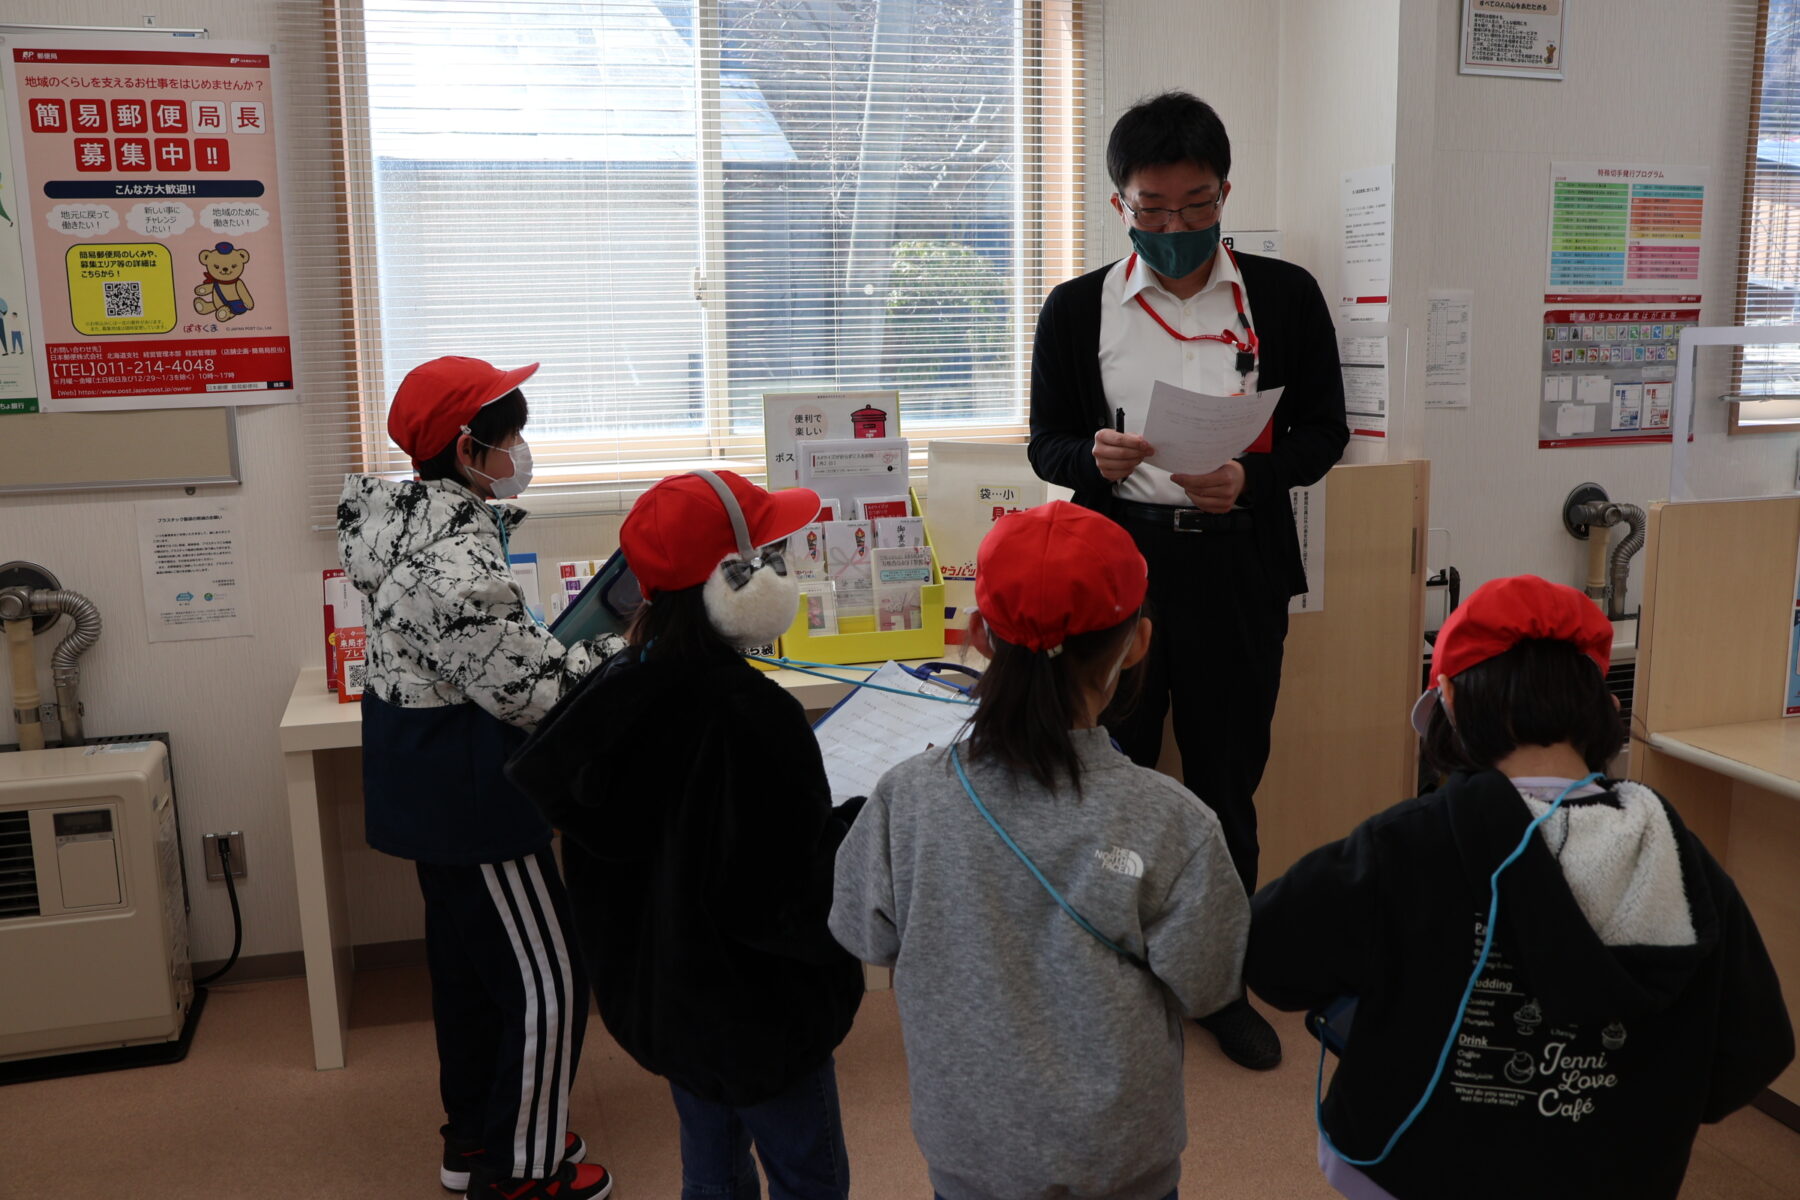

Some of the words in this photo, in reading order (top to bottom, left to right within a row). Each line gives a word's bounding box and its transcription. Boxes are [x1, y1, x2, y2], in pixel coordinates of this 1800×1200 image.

[25, 76, 264, 91] 地域のくらしを支えるお仕事をはじめませんか？
[35, 103, 261, 128] 簡易郵便局長
[1597, 169, 1665, 178] 特殊切手発行プログラム
[115, 184, 196, 195] こんな方大歓迎!!
[60, 210, 110, 220] 地元に戻って
[144, 206, 181, 215] 新しい事に
[212, 208, 260, 217] 地域のために
[145, 216, 177, 224] チャレンジ
[794, 413, 822, 423] 便利で
[795, 427, 822, 436] 楽しい
[1475, 978, 1512, 993] udding
[1459, 1033, 1488, 1047] Drink
[1539, 1042, 1608, 1075] Jenni
[1558, 1069, 1618, 1094] Love
[1455, 1086, 1474, 1095] What
[1538, 1088, 1595, 1122] Café
